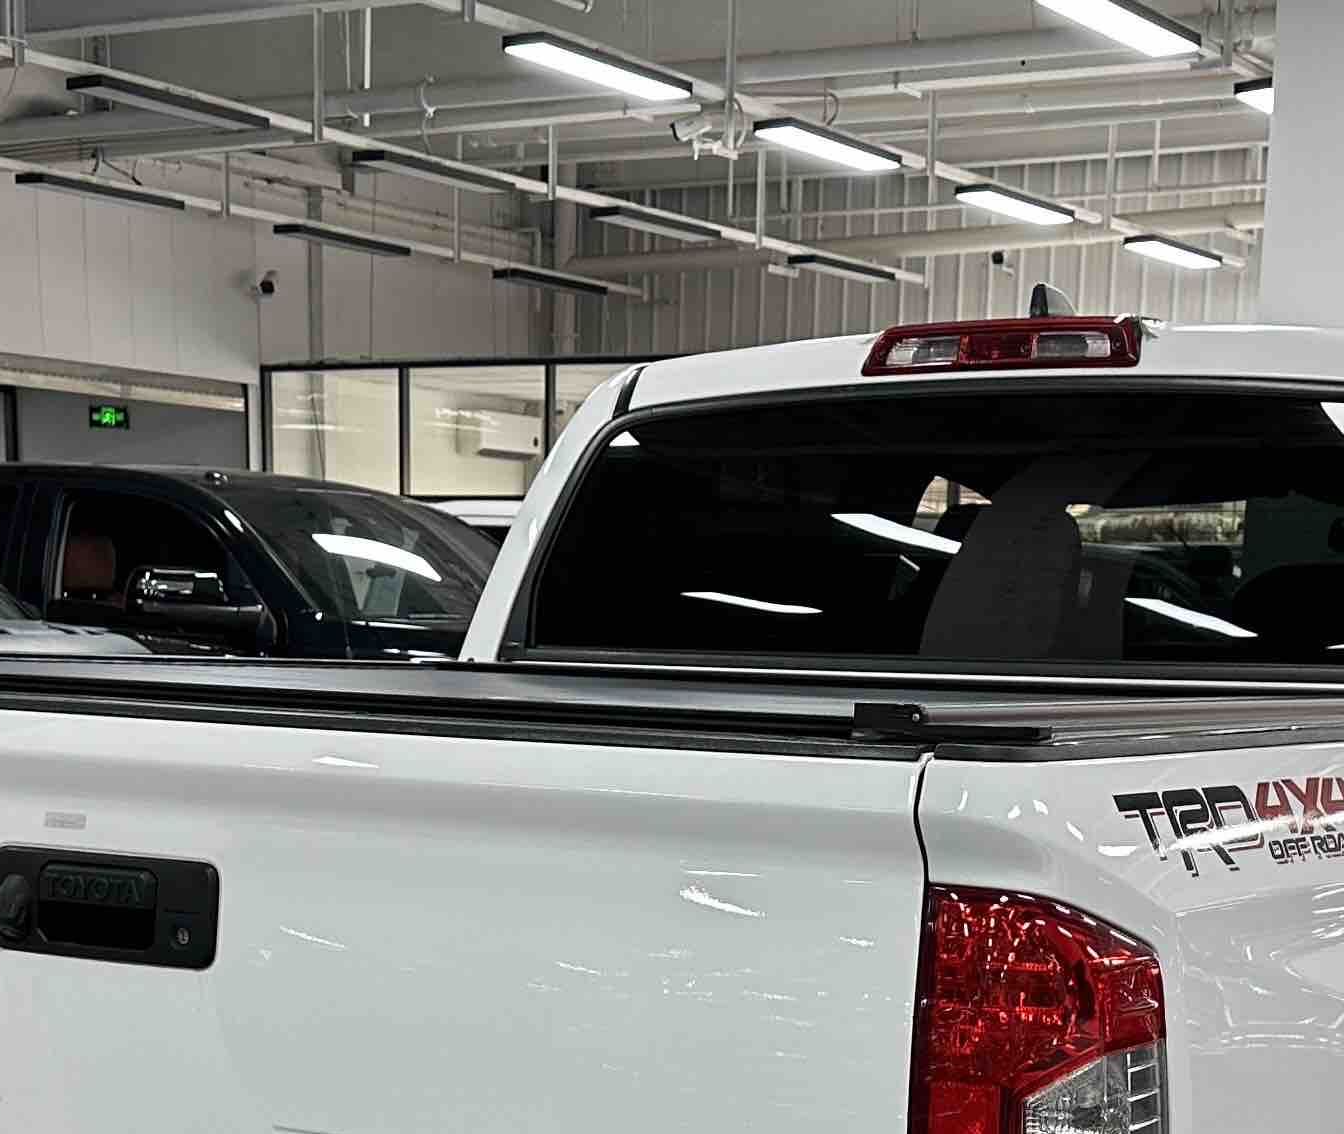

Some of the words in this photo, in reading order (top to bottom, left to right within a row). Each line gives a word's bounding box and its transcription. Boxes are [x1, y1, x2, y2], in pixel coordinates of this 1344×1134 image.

[1112, 785, 1264, 877] TRD
[1269, 836, 1310, 863] OFF
[46, 873, 141, 903] TOYOTA
